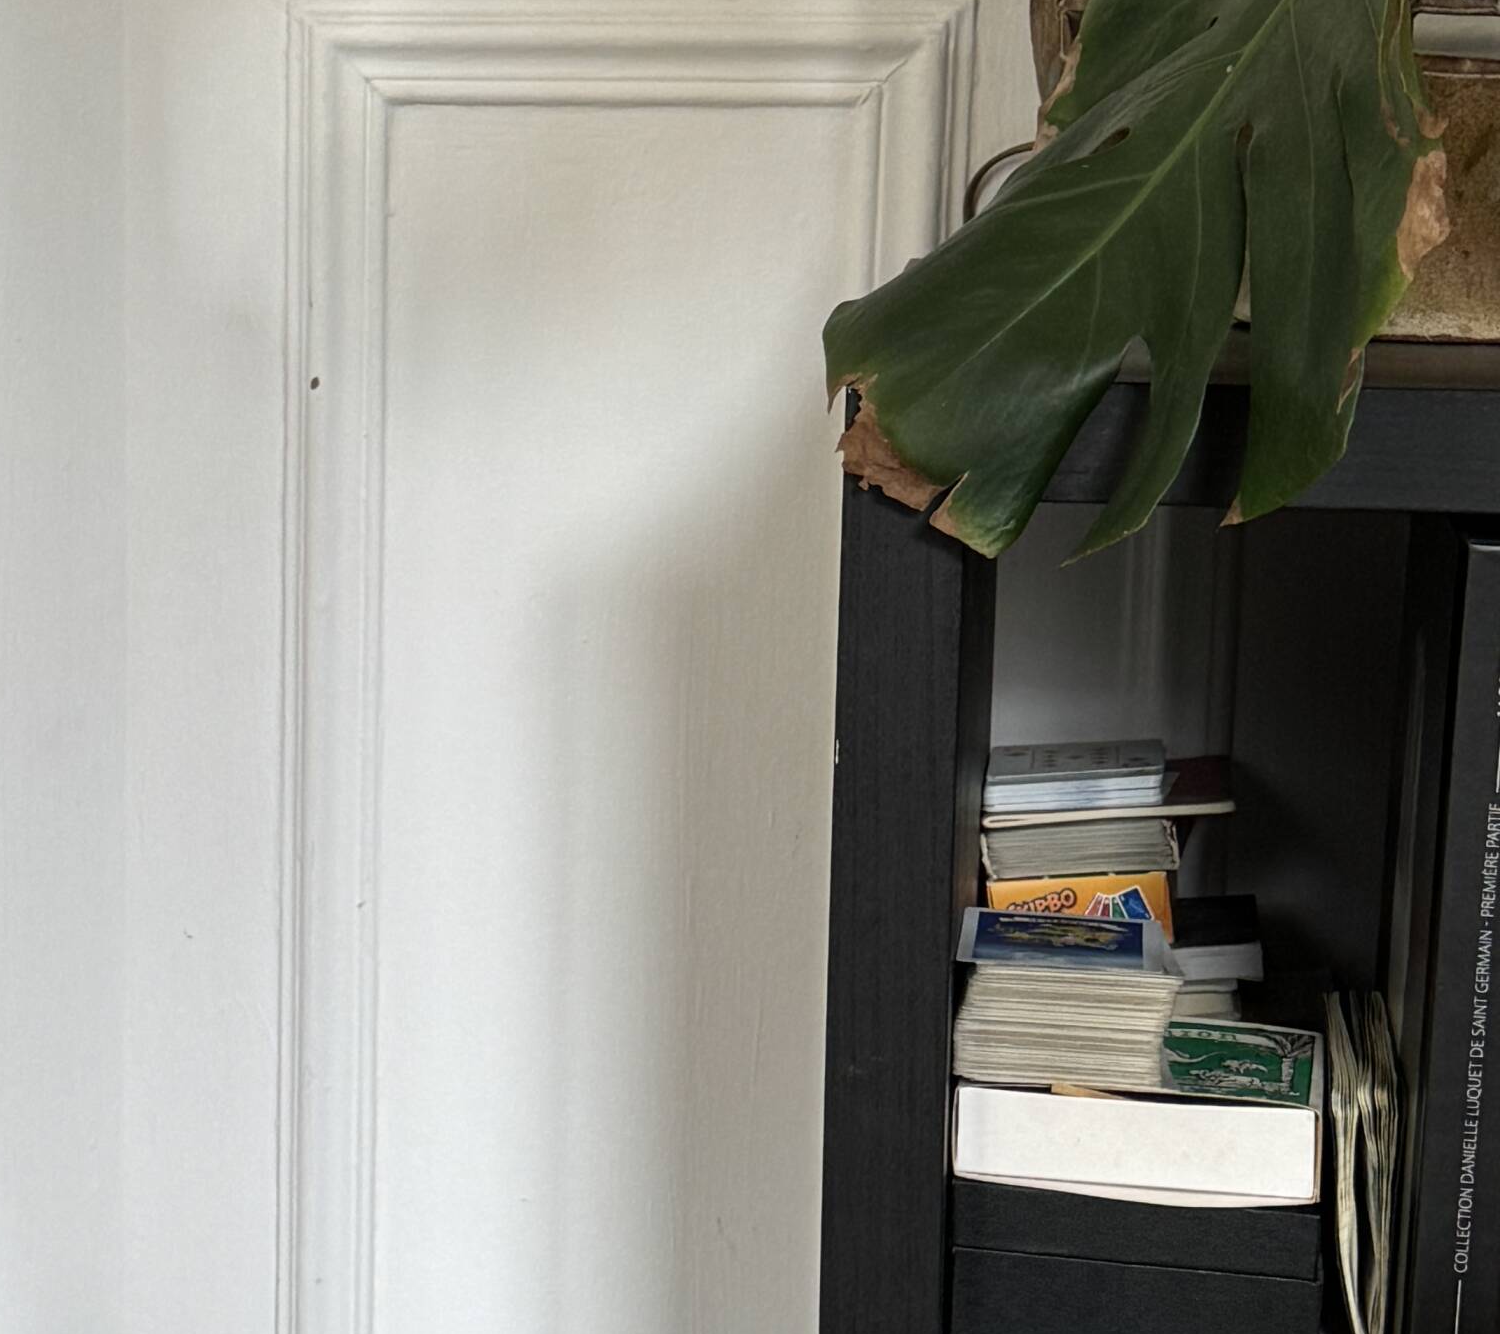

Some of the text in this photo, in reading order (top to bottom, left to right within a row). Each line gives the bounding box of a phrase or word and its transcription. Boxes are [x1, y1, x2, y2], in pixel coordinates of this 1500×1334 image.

[1480, 850, 1500, 918] PREMIÈRE
[1474, 929, 1493, 994] GERMAIN
[1468, 1038, 1485, 1058] DE
[1470, 995, 1488, 1037] SAINT
[1466, 1062, 1483, 1116] LUQUET
[1461, 1119, 1479, 1185] DANIELLE
[1454, 1188, 1474, 1274] COLLECTION
